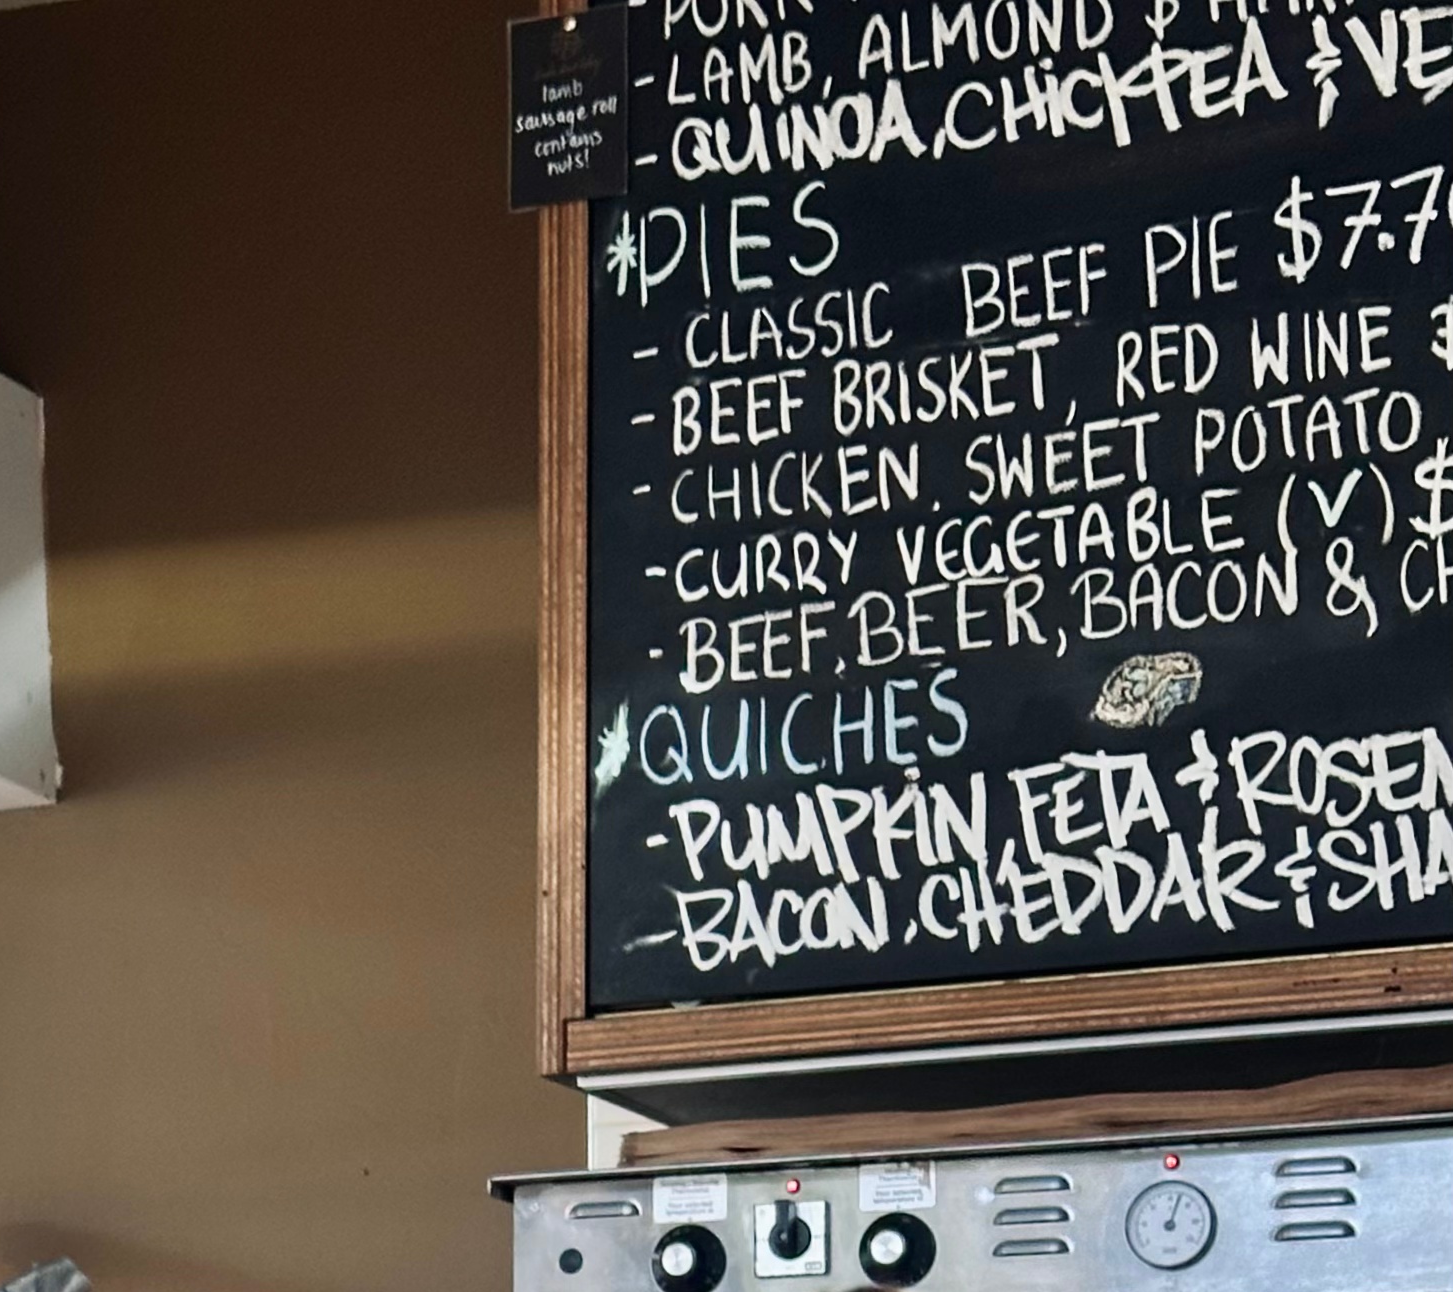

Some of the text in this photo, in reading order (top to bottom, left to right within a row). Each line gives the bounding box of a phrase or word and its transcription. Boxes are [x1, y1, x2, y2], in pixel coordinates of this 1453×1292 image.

[542, 79, 583, 103] lamb
[667, 30, 834, 106] LAMB,
[858, 0, 1114, 80] ALMOND
[515, 95, 617, 136] sausage roll
[535, 131, 602, 157] contains
[547, 149, 590, 176] nuts!
[685, 281, 892, 369] CLASSIC
[960, 243, 1107, 339] BEEF
[1145, 211, 1239, 308] PIE
[672, 369, 807, 456] BEEF
[1116, 323, 1219, 407] RED
[1251, 306, 1392, 390] WINE
[965, 412, 1161, 505] SWEET
[1195, 389, 1422, 476] POTATO
[675, 529, 858, 602] CURRY
[897, 486, 1245, 586] VEGETABLE
[1070, 553, 1299, 639] BACON
[1326, 536, 1378, 637] &
[640, 667, 969, 785] QUICHES
[1007, 750, 1171, 865] FETA
[918, 808, 1281, 951] CHEDDAR
